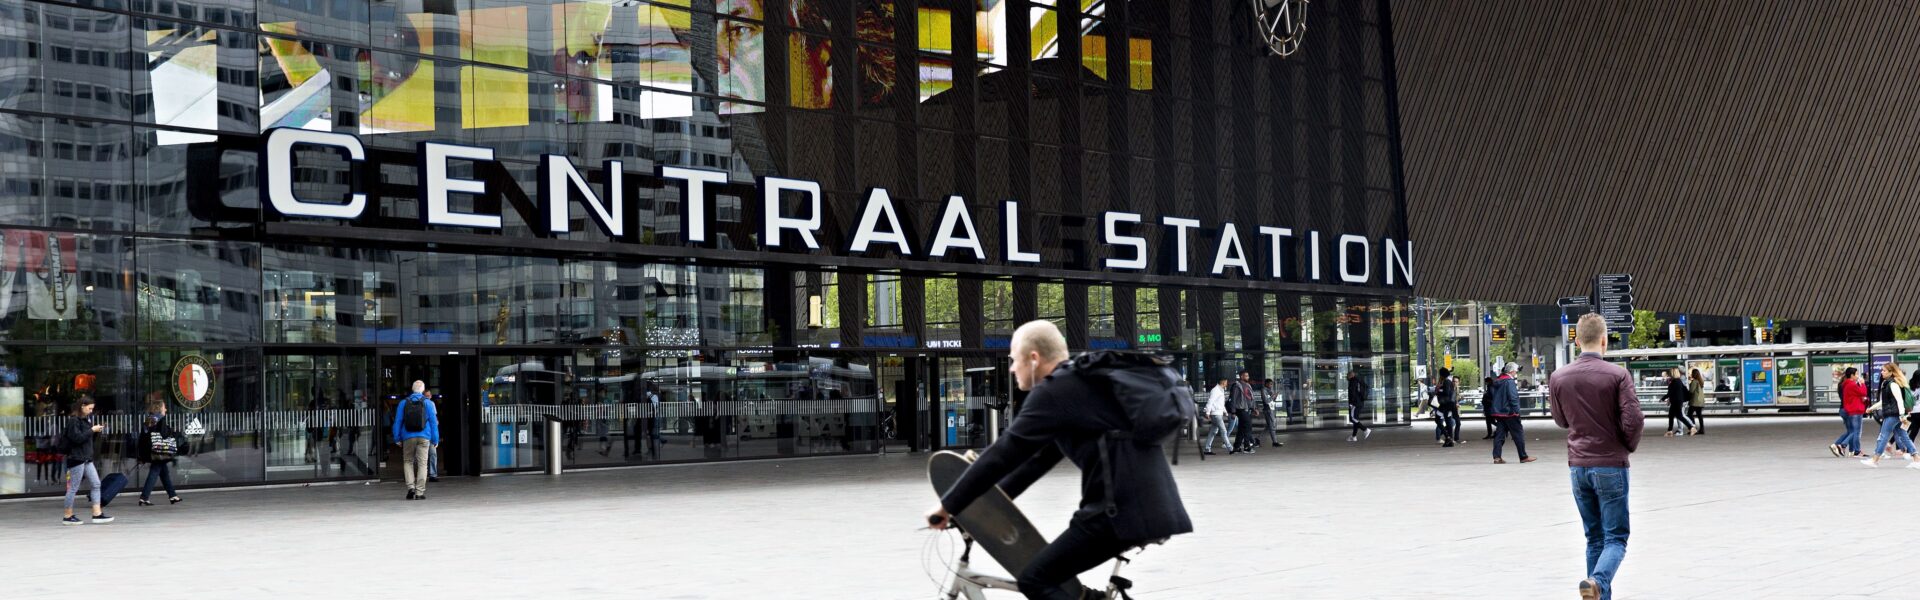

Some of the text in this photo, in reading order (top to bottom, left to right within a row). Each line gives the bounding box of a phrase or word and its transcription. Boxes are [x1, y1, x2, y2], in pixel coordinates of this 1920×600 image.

[265, 126, 1414, 286] CENTRAAL STATION
[185, 427, 206, 435] adidas
